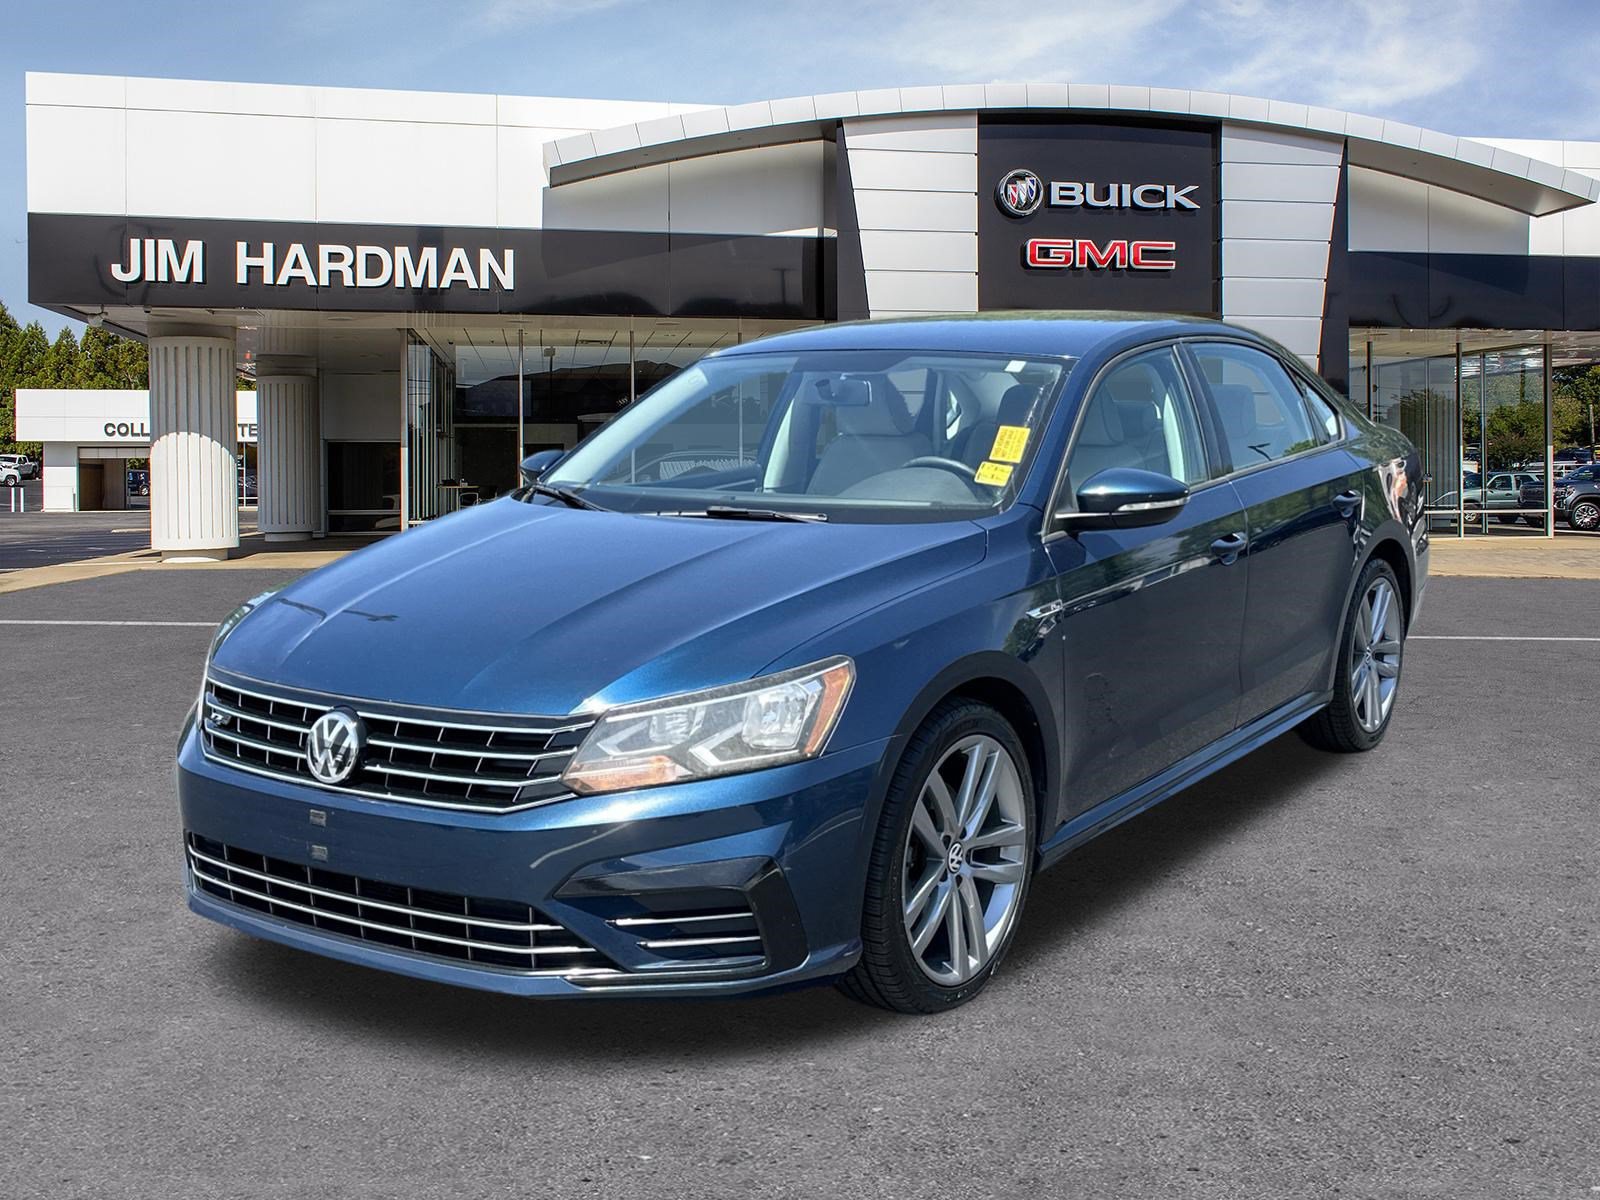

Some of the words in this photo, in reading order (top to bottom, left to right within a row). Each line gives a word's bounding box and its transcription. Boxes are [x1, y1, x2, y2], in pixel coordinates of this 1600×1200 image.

[1050, 181, 1200, 209] BUICK
[111, 238, 203, 283] JIM
[236, 240, 514, 290] HARDMAN
[1026, 238, 1176, 269] GMC
